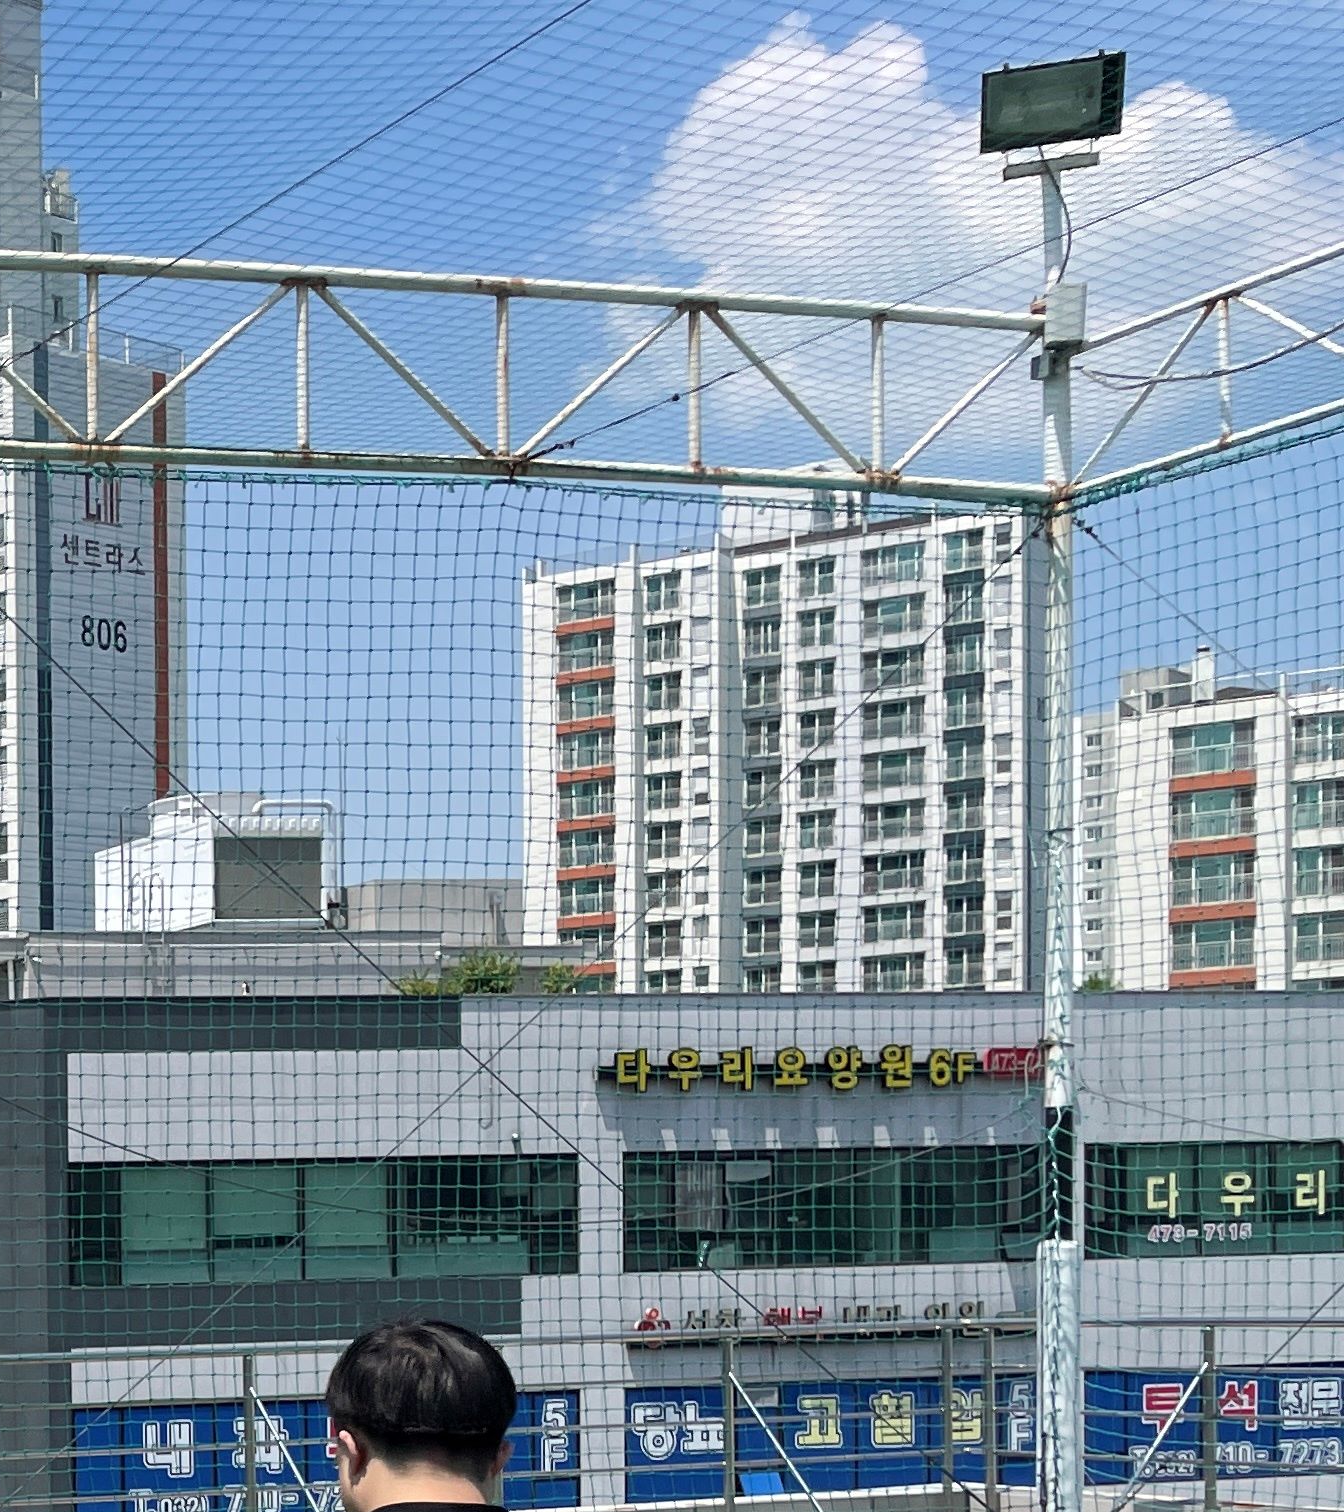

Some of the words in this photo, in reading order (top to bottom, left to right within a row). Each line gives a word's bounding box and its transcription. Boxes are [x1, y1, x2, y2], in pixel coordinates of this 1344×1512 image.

[61, 533, 146, 576] 센트라스
[81, 614, 128, 655] 806
[1147, 1222, 1253, 1243] 473-7115
